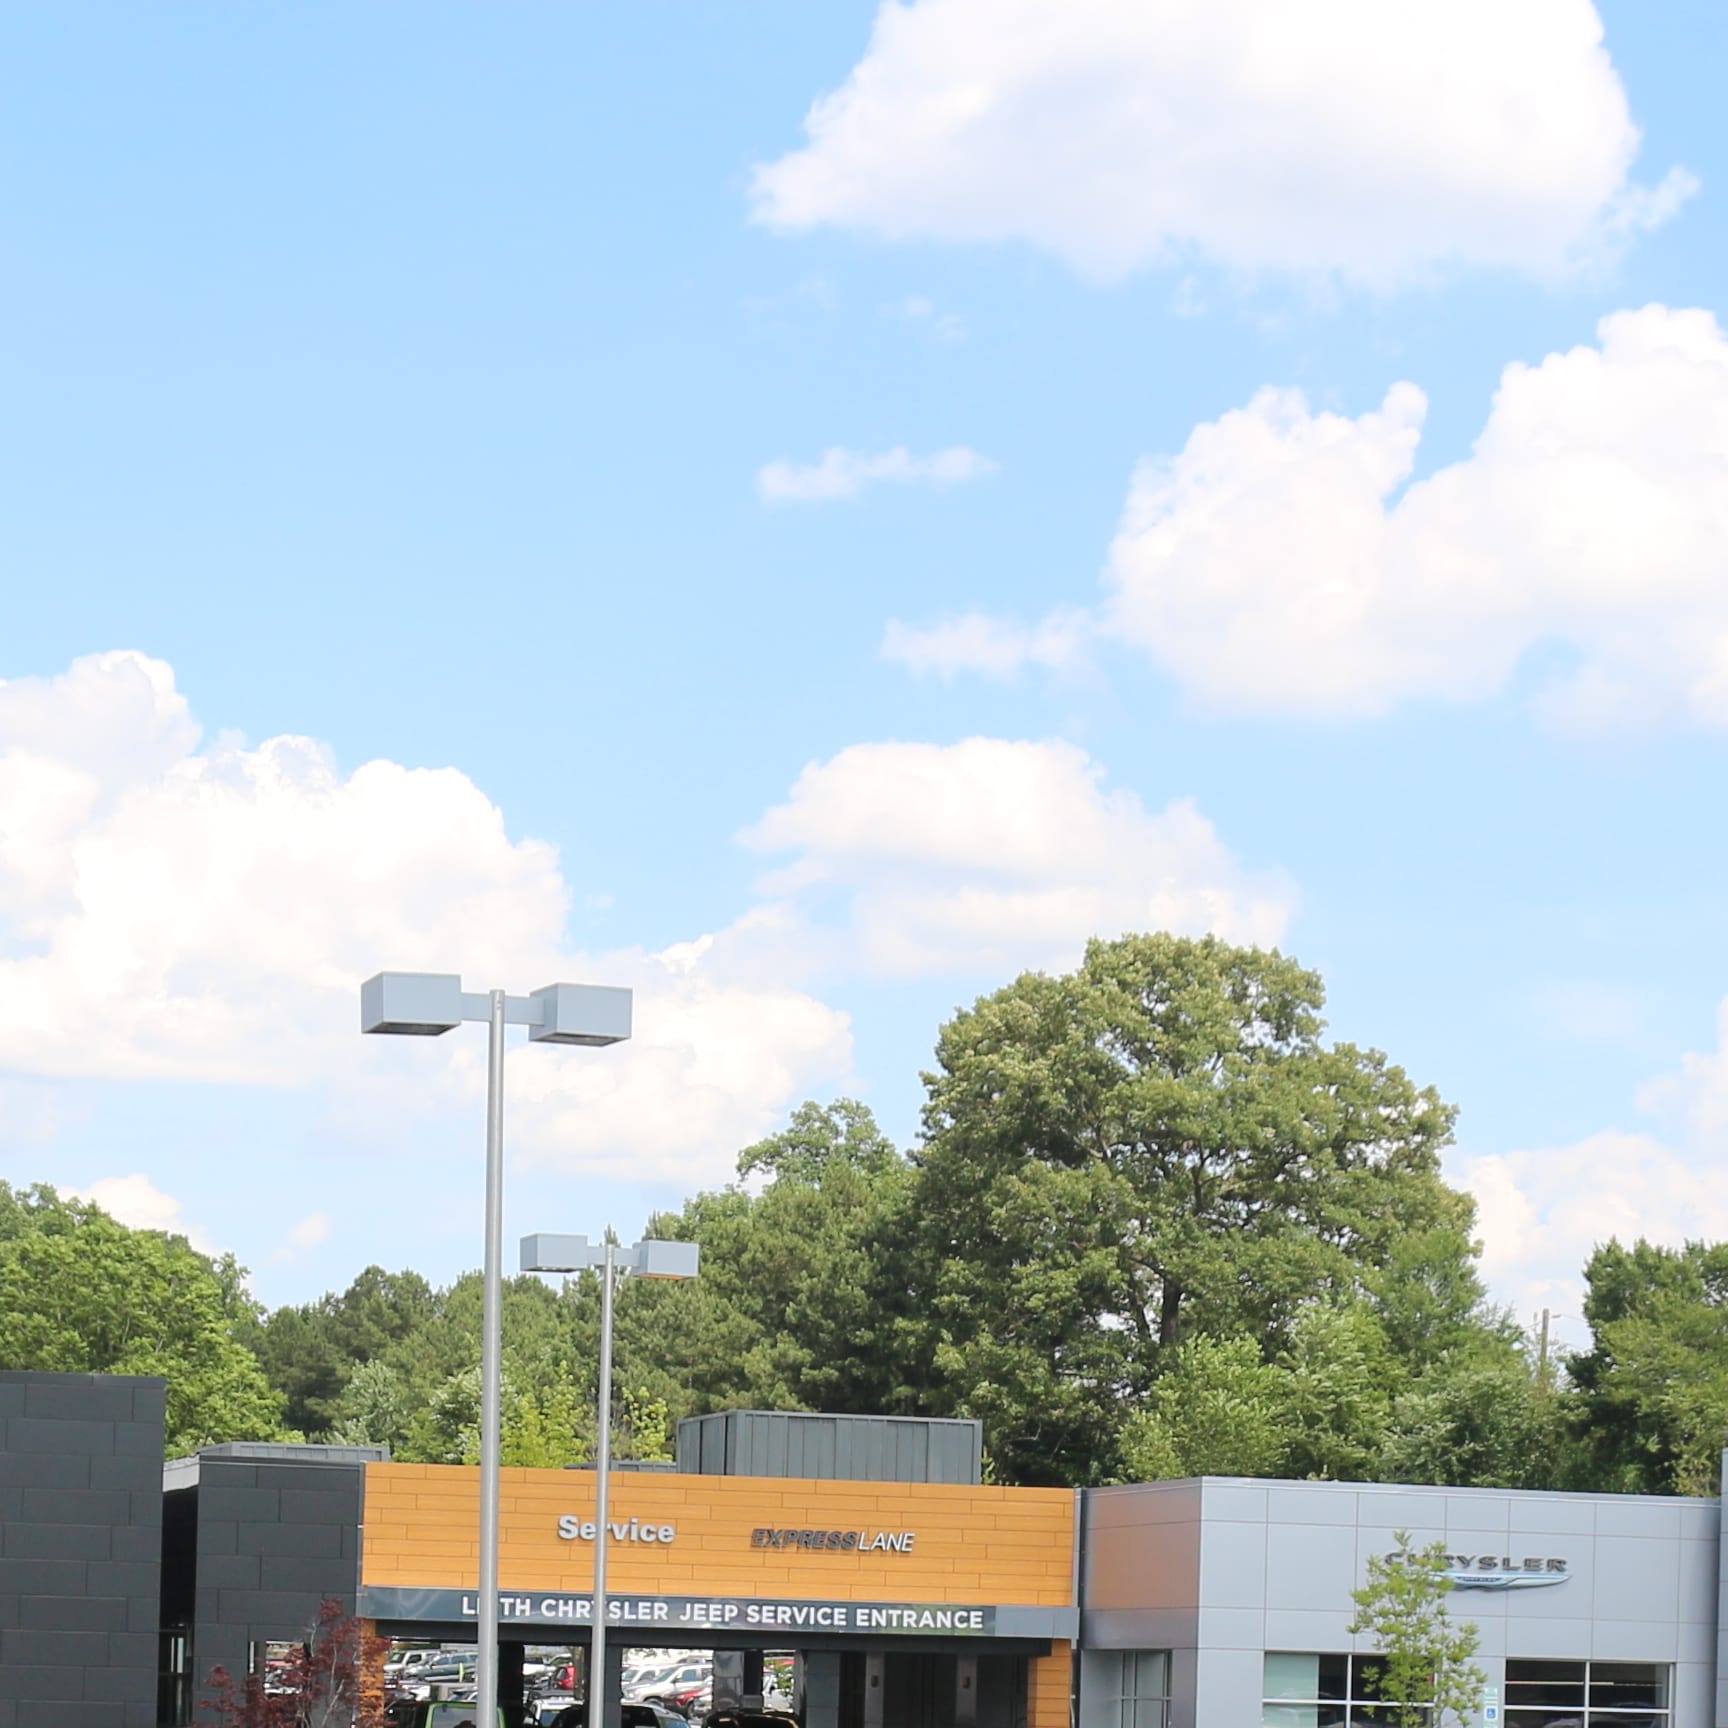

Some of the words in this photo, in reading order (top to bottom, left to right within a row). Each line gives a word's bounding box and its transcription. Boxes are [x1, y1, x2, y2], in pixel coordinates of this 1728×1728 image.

[558, 1515, 675, 1543] Sevice
[462, 1597, 531, 1617] LTH
[540, 1598, 668, 1621] CHRSLER
[680, 1602, 738, 1623] JEEP
[746, 1604, 847, 1626] SERVICE
[856, 1608, 983, 1629] ENTRANCE
